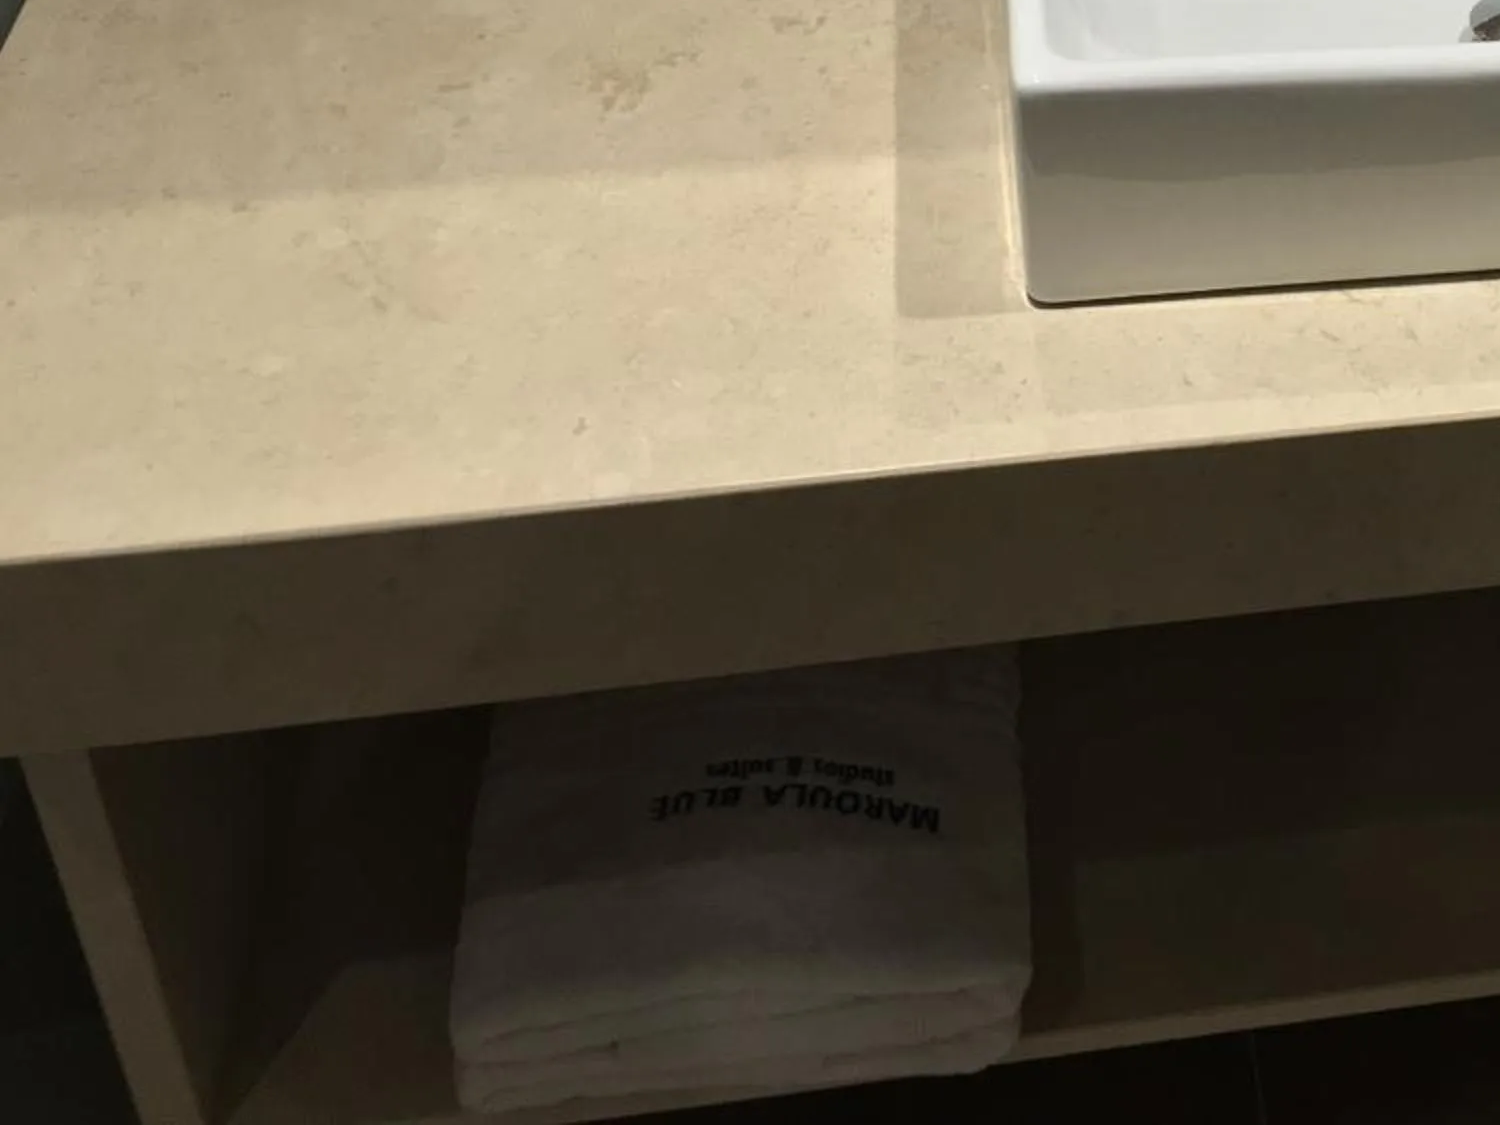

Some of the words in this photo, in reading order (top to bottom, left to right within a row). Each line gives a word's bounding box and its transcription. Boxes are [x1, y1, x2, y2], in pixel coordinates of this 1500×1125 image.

[705, 758, 775, 780] suites
[813, 758, 896, 787] studios
[648, 786, 742, 821] BLUE
[763, 783, 941, 834] MAROULA
